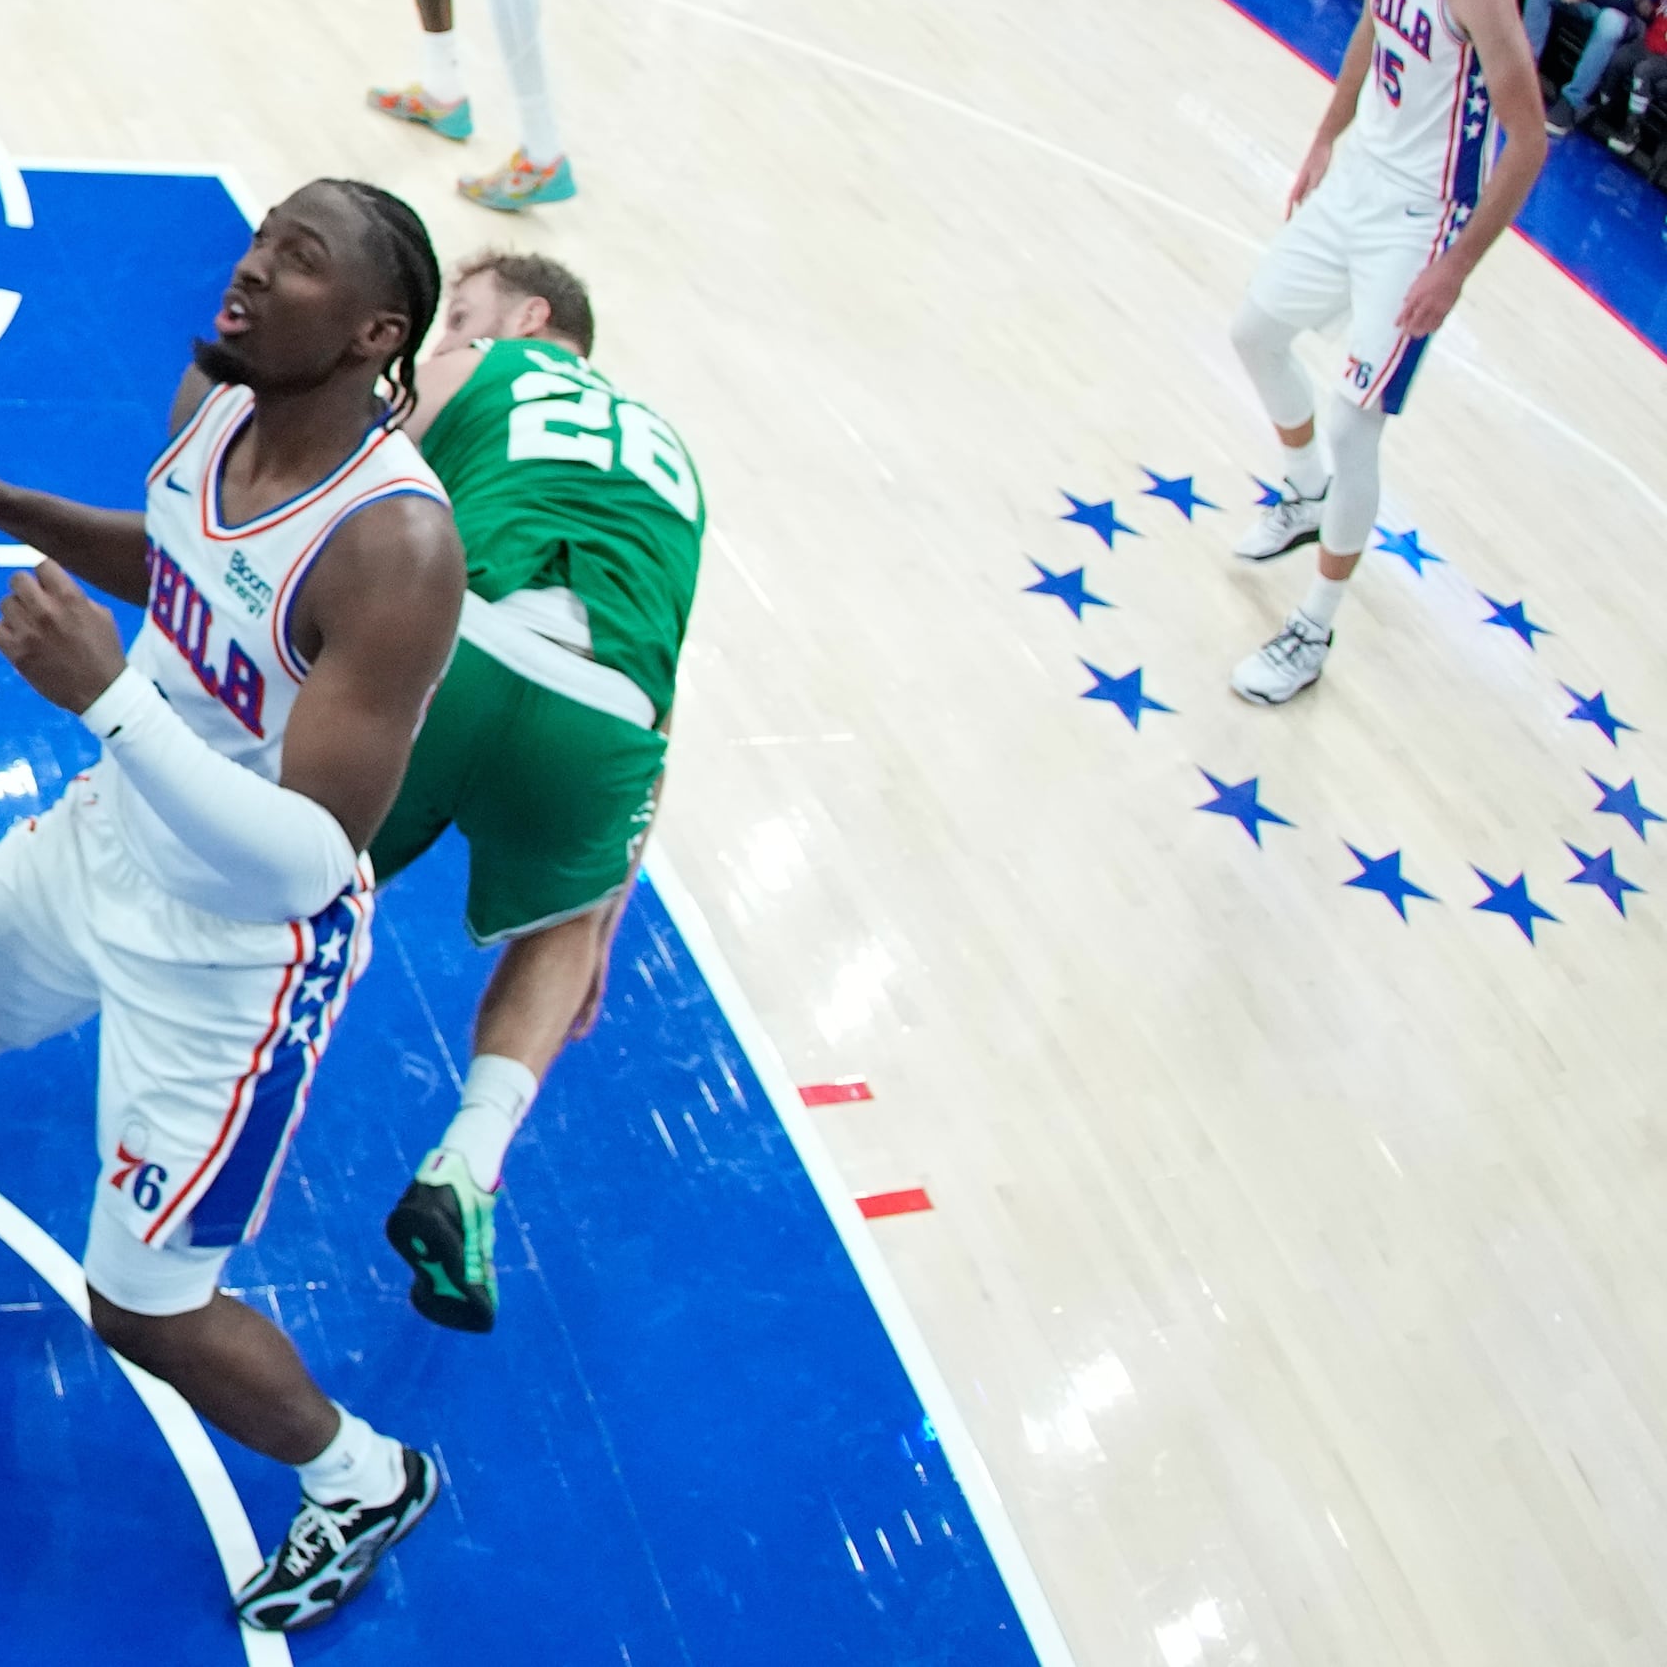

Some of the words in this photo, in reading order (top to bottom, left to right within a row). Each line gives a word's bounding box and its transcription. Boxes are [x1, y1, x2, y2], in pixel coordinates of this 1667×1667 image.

[1343, 354, 1373, 389] 76
[145, 530, 266, 741] HILA
[108, 1140, 168, 1212] 76
